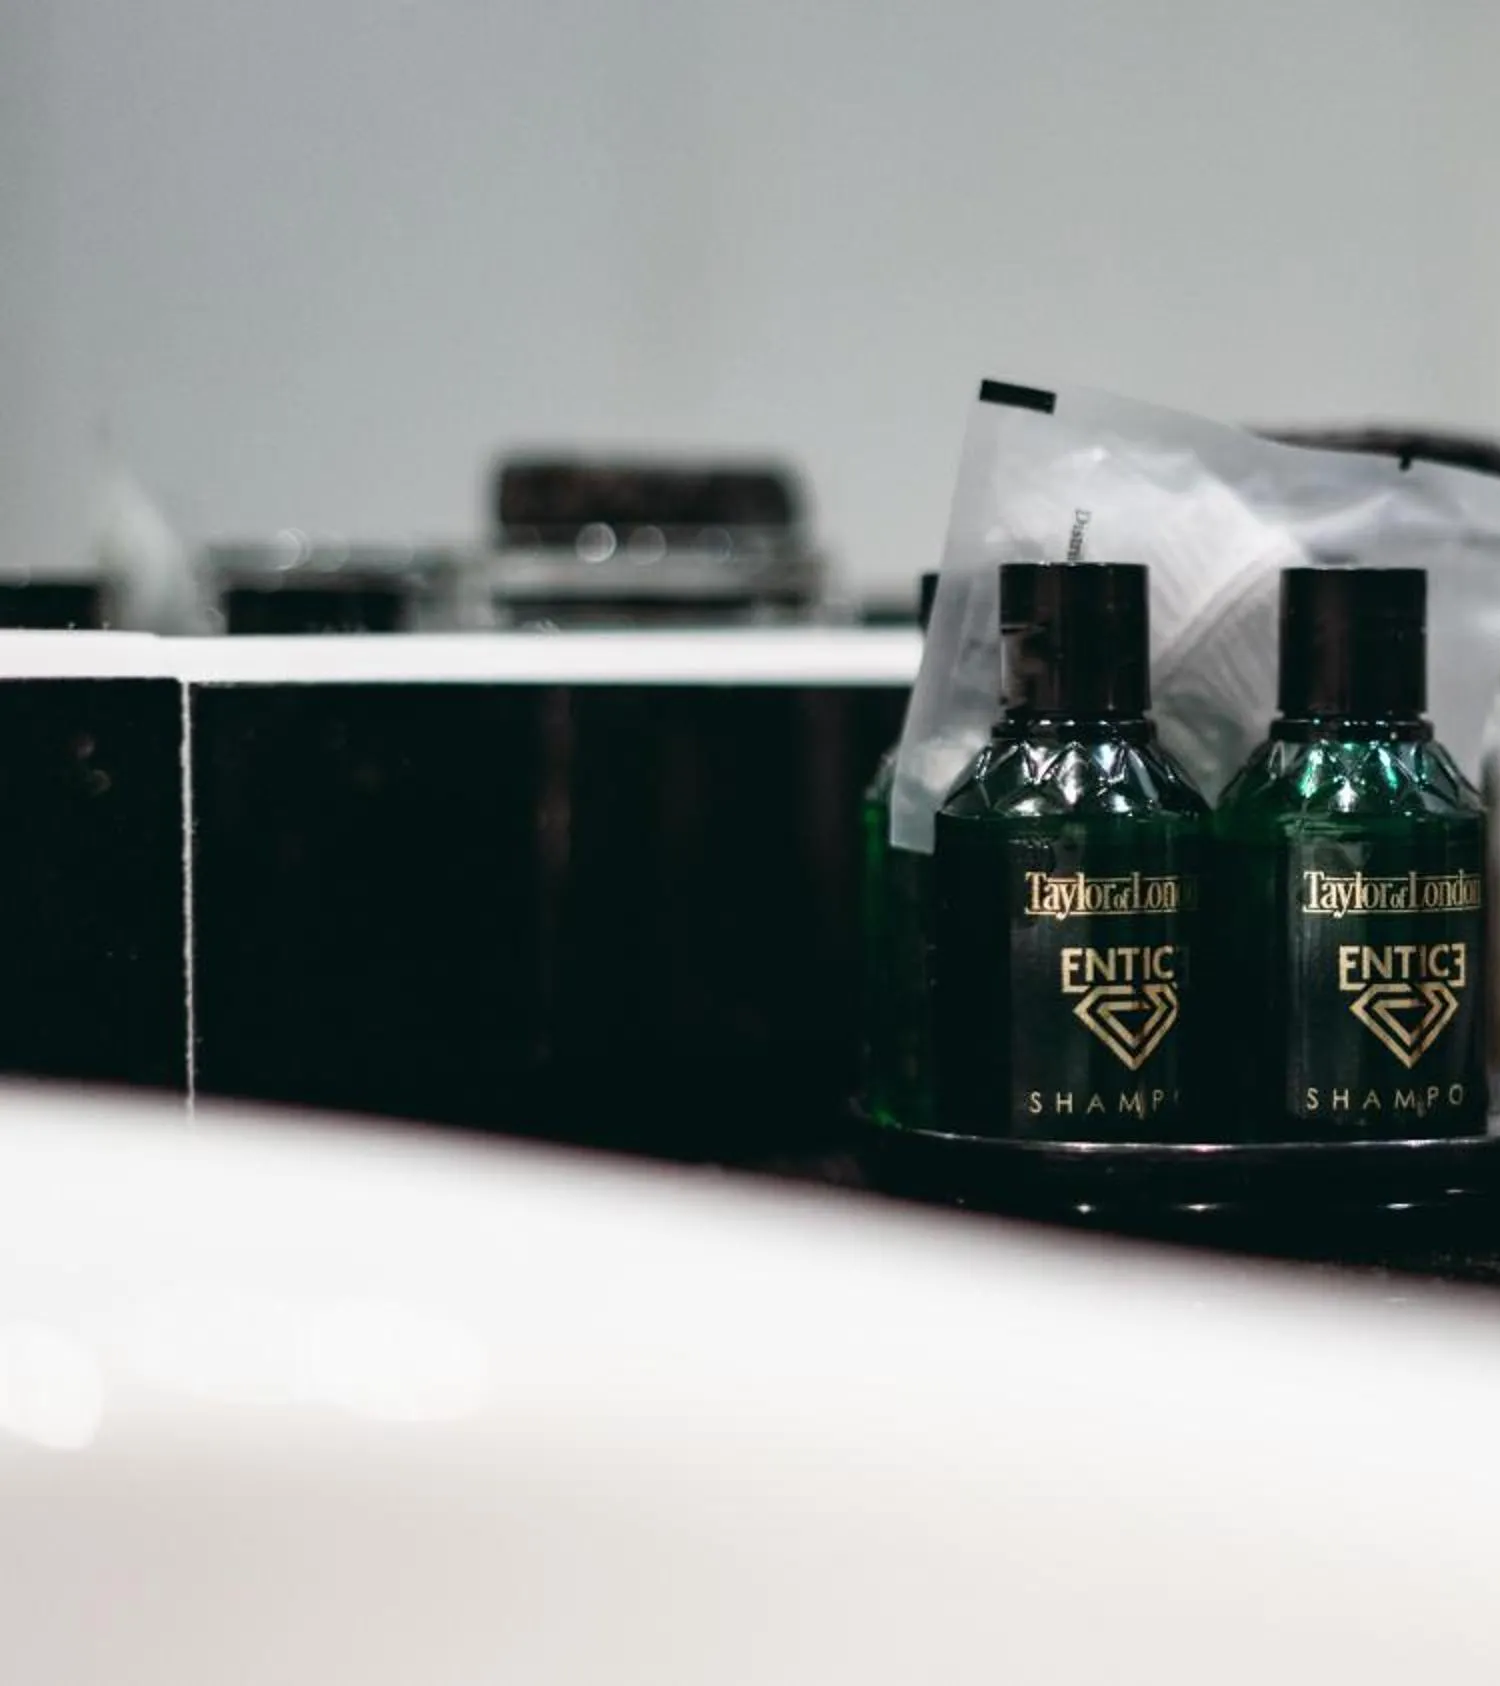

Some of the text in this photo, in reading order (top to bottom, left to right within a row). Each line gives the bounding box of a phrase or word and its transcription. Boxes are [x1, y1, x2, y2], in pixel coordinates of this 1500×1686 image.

[1025, 871, 1117, 920] Taylor
[1303, 869, 1394, 918] Taylor
[1060, 945, 1177, 994] ENTIC
[1338, 943, 1467, 992] ENTICE
